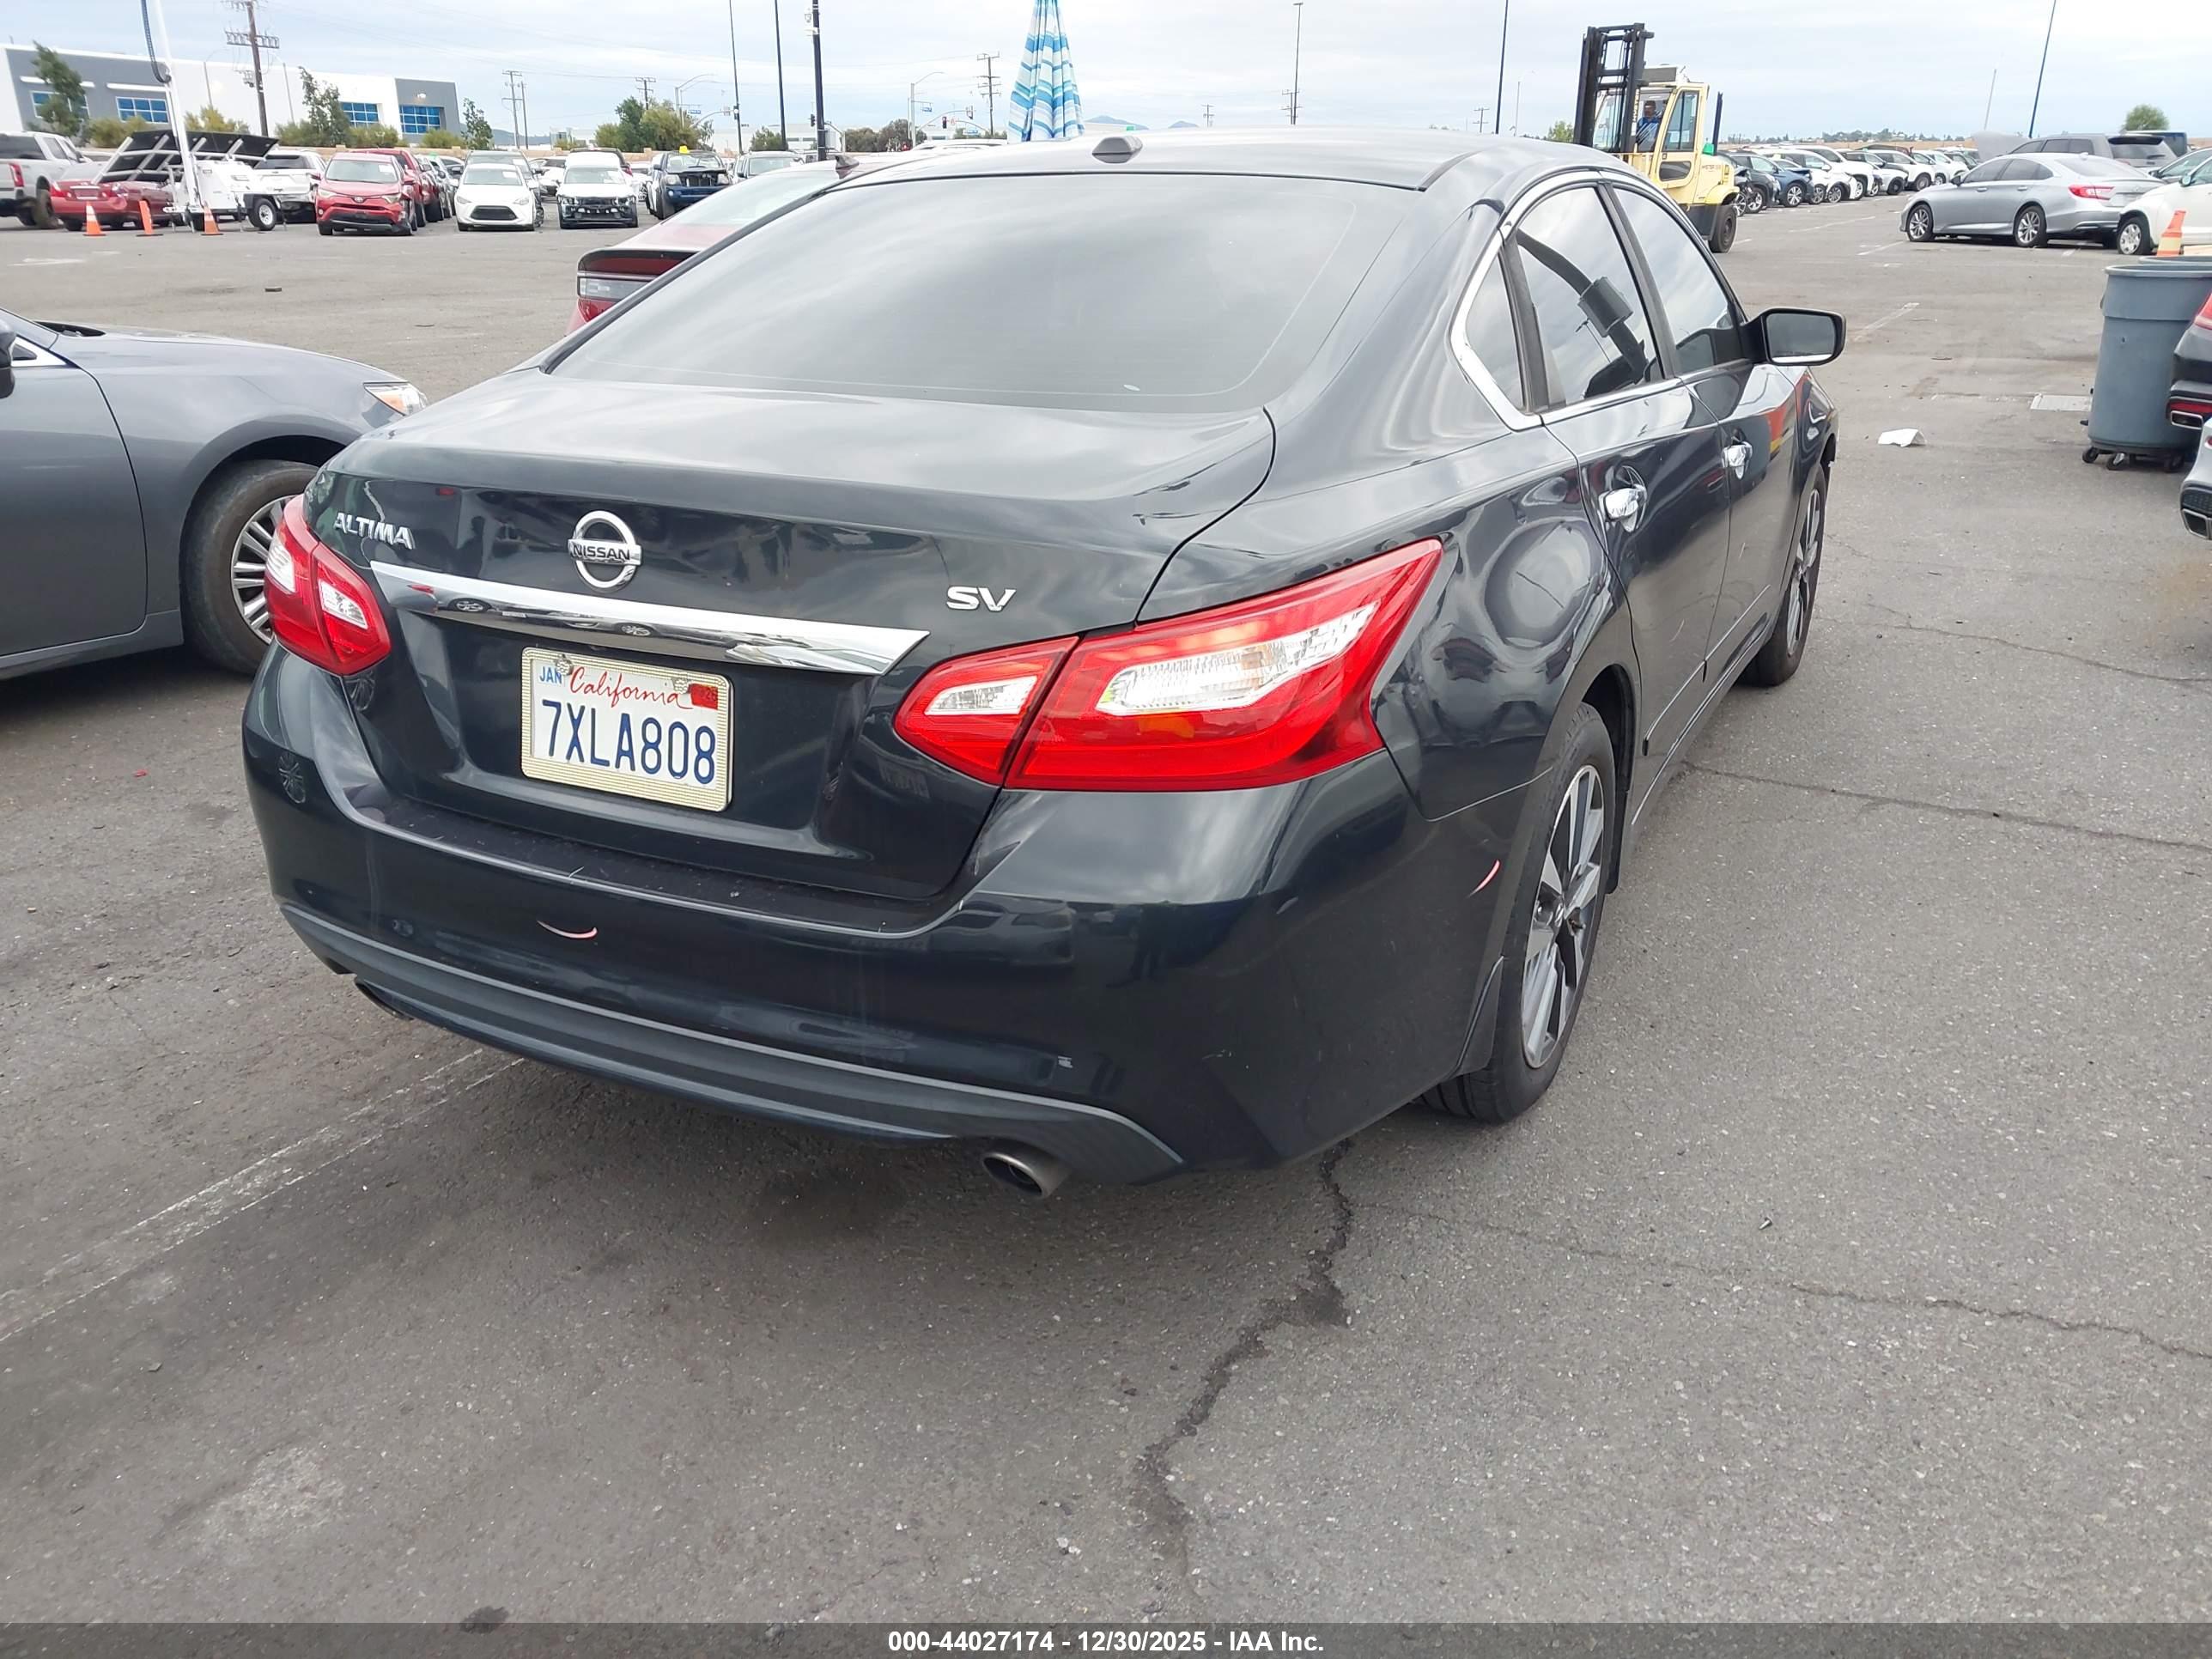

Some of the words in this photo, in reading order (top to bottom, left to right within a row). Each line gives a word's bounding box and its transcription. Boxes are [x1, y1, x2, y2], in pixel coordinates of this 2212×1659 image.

[333, 512, 416, 550] ALTIMA
[573, 544, 630, 561] NISSAN
[946, 586, 1017, 611] SV
[539, 665, 562, 684] JAN
[570, 666, 693, 709] California
[542, 699, 716, 785] 7XLA808
